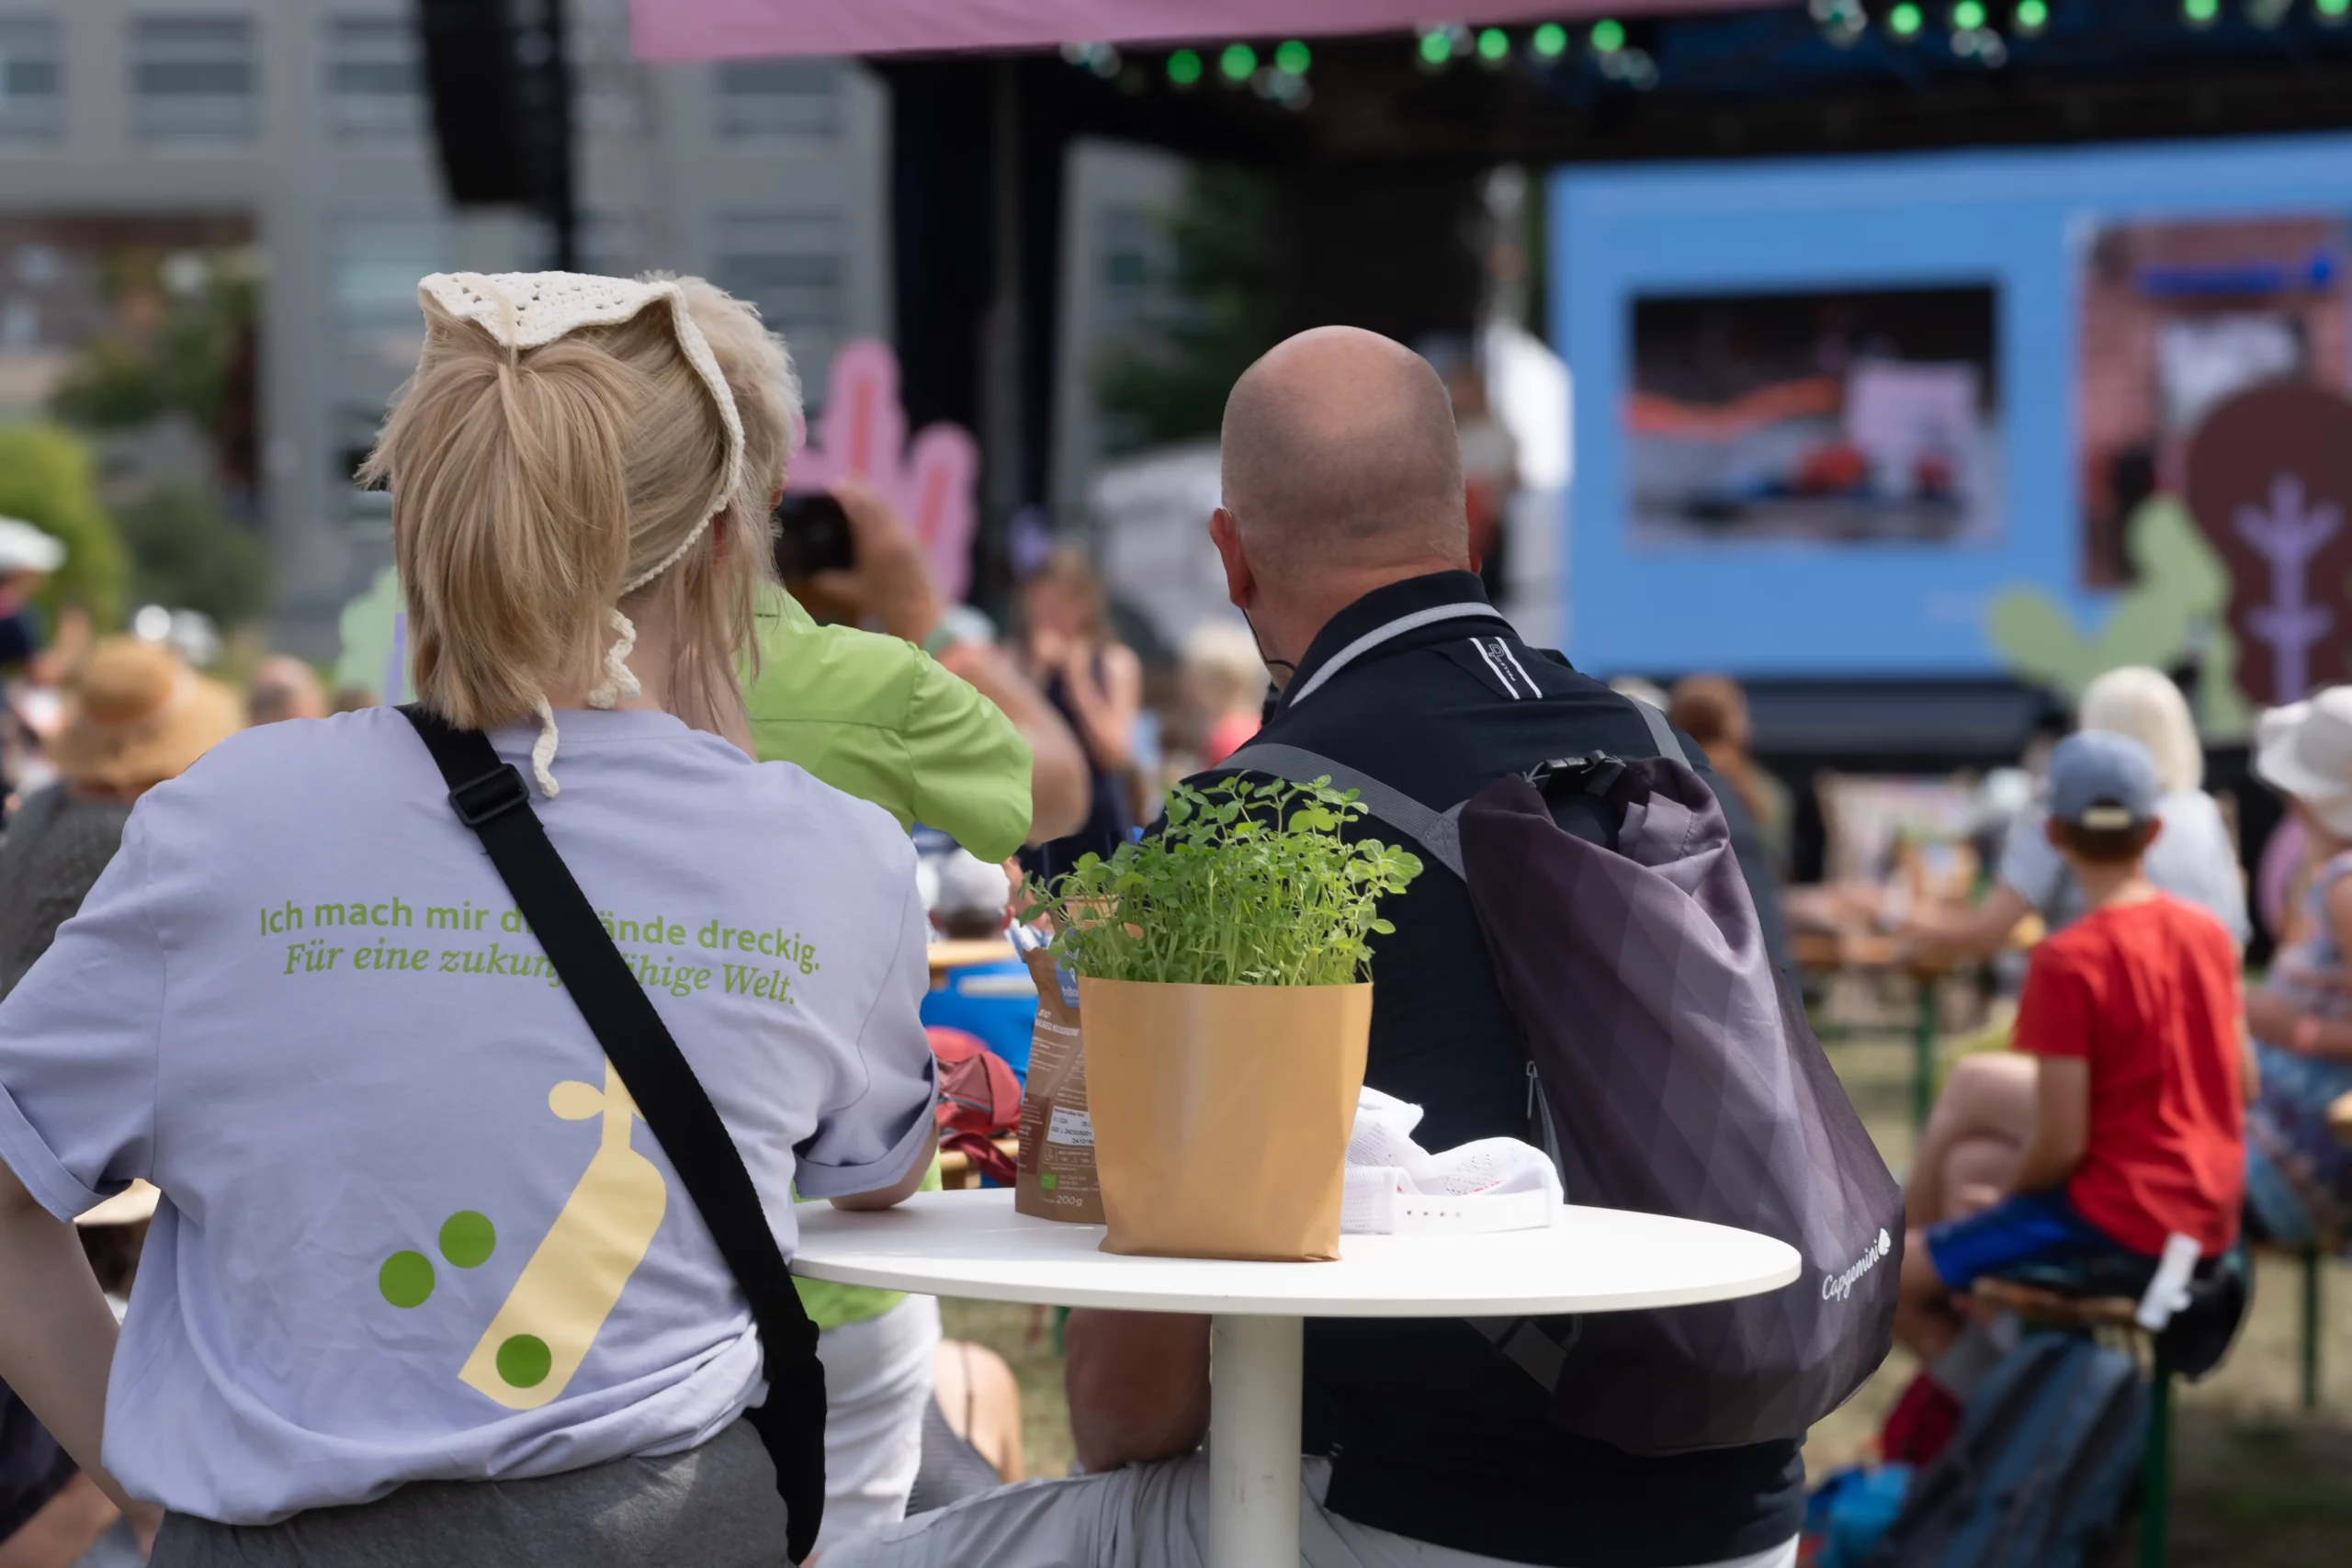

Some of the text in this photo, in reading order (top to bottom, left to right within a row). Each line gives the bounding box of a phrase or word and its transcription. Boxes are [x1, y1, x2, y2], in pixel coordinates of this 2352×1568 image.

[260, 899, 303, 937] Ich
[313, 896, 413, 928] mach
[425, 899, 490, 931] mir
[597, 910, 687, 946] ände
[696, 919, 820, 975] dreckig.
[283, 938, 345, 976] Für
[353, 937, 430, 971] eine
[721, 963, 796, 1005] Welt.
[1822, 1238, 1880, 1302] Capgemini
